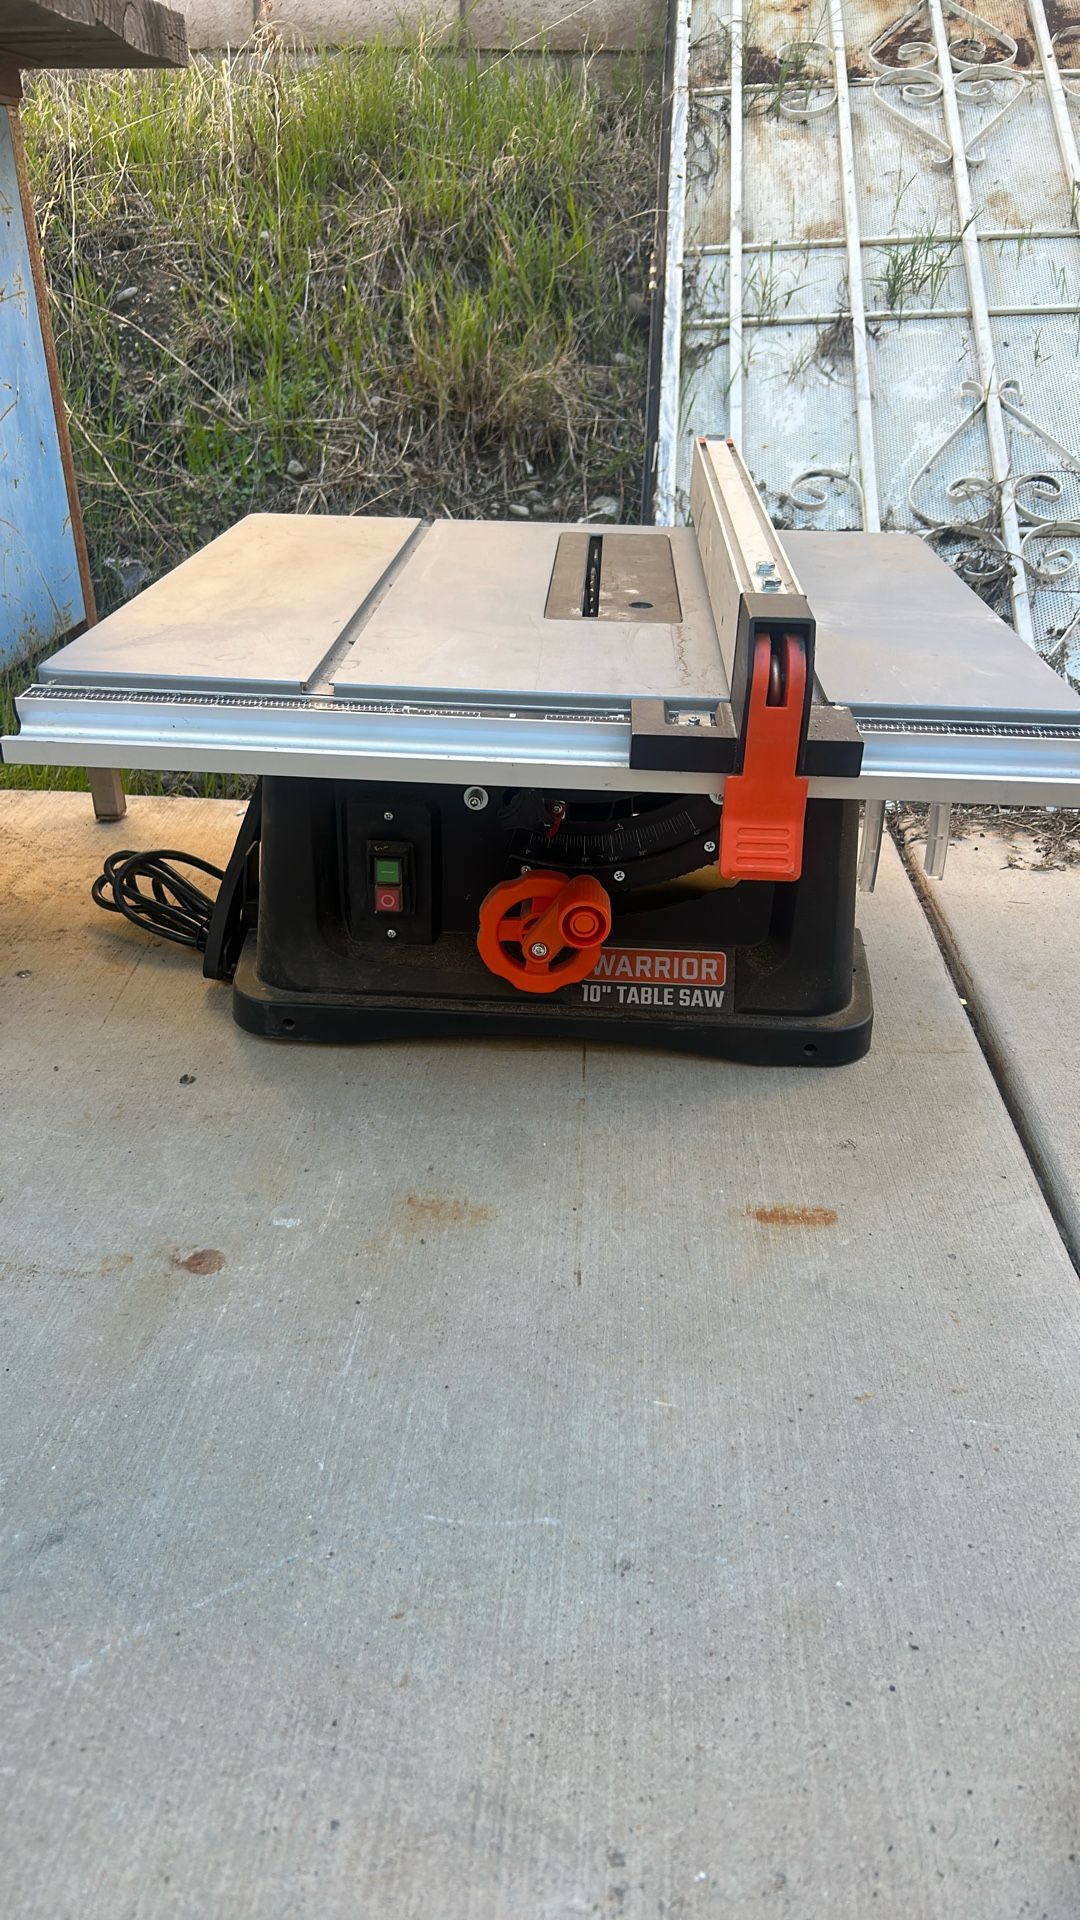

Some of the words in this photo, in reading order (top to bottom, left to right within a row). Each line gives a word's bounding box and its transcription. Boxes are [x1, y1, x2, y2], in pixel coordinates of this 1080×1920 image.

[594, 955, 718, 981] WARRIOR
[582, 984, 611, 1002] 10"
[616, 986, 674, 1006] TABLE
[679, 989, 725, 1008] SAW
